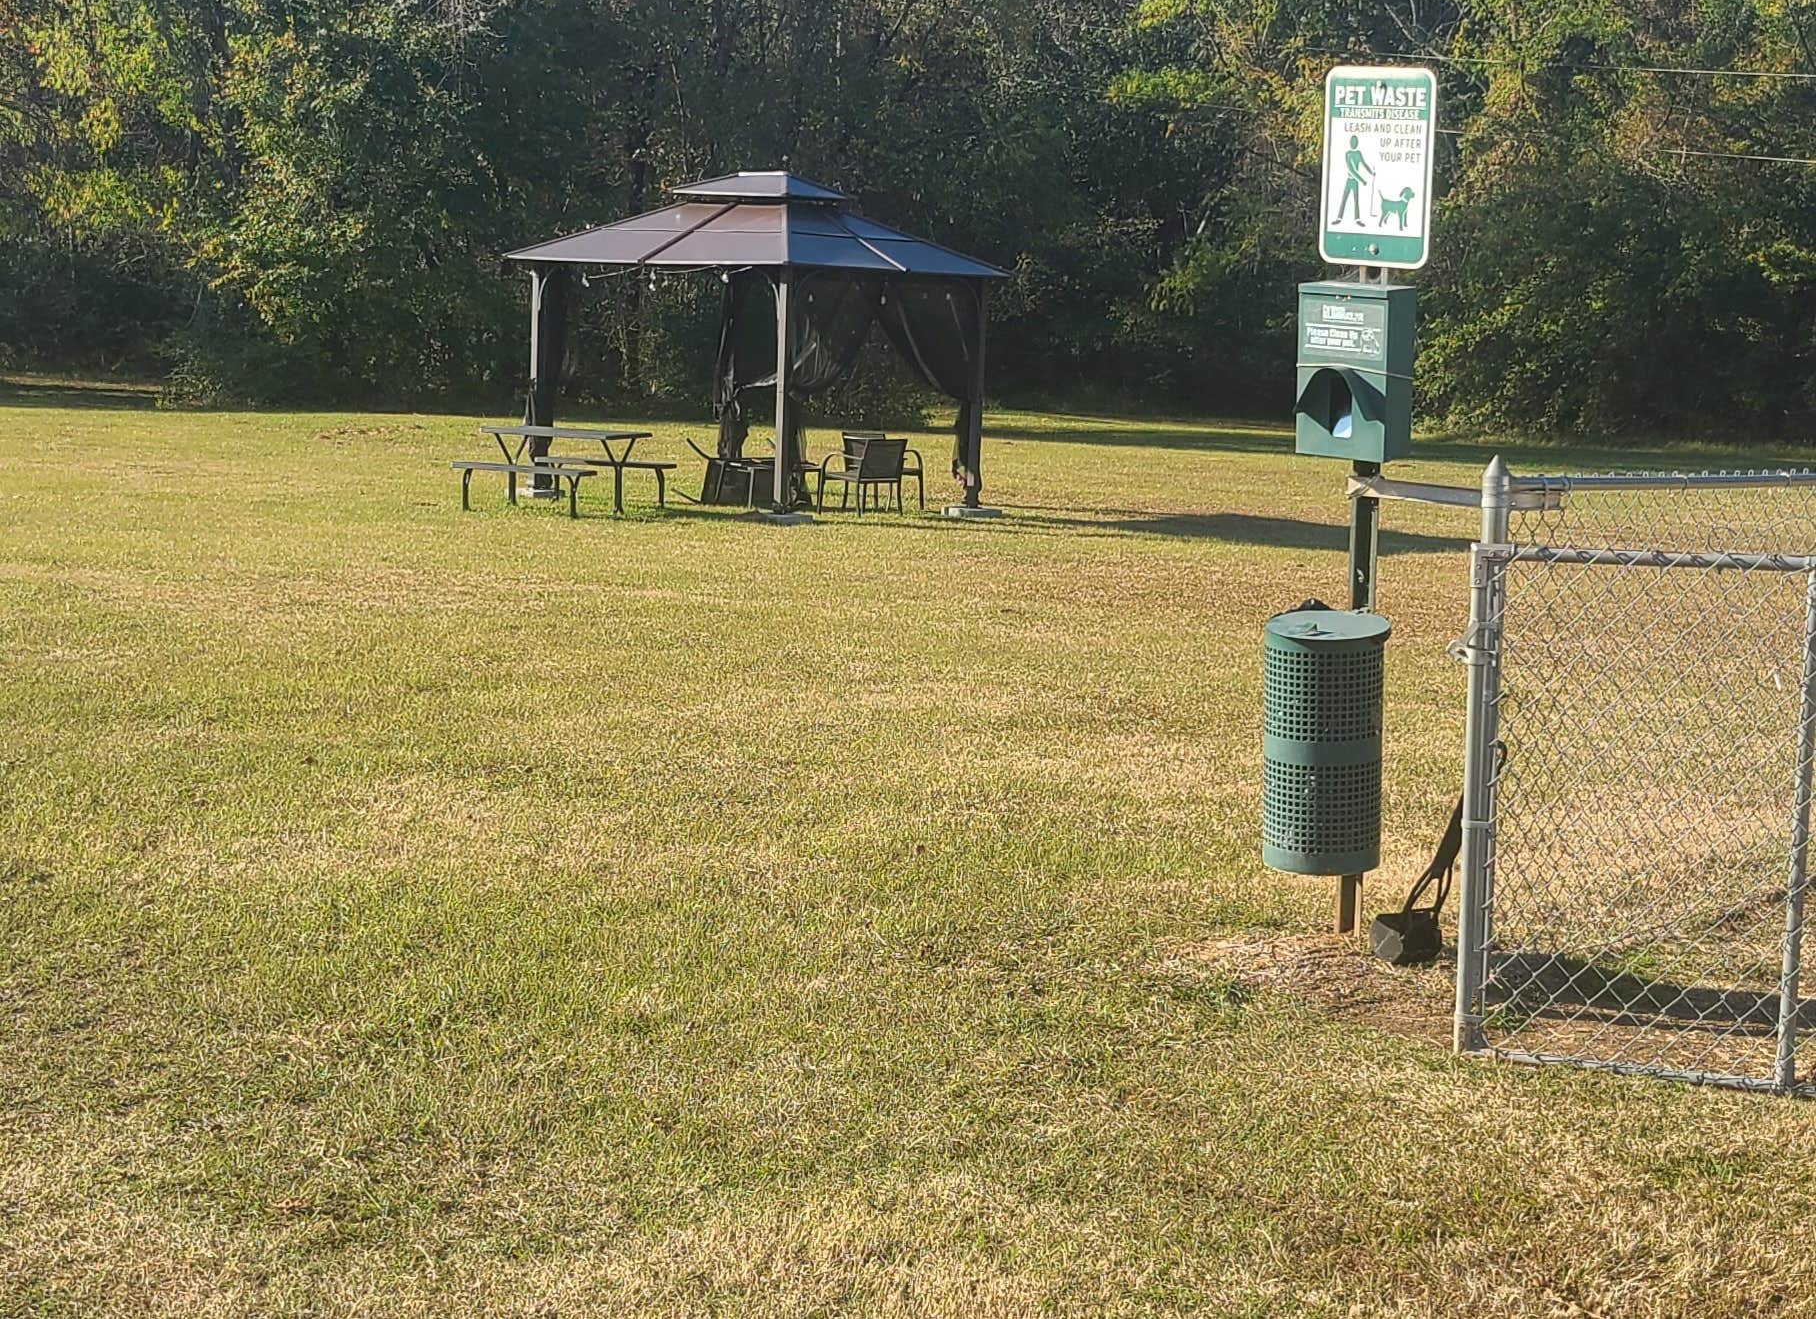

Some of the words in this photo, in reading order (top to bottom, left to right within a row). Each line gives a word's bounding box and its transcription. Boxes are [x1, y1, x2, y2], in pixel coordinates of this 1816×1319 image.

[1335, 85, 1366, 105] PET
[1370, 86, 1427, 107] WASTE
[1339, 107, 1385, 119] TRANSMITS
[1386, 109, 1420, 120] DISEASE
[1344, 122, 1371, 132] LEASH
[1374, 123, 1392, 134] AND
[1394, 124, 1422, 135] CLEAN
[1380, 138, 1392, 148] UP
[1394, 138, 1422, 149] AFTER
[1379, 152, 1402, 162] YOUR
[1404, 153, 1422, 163] PET
